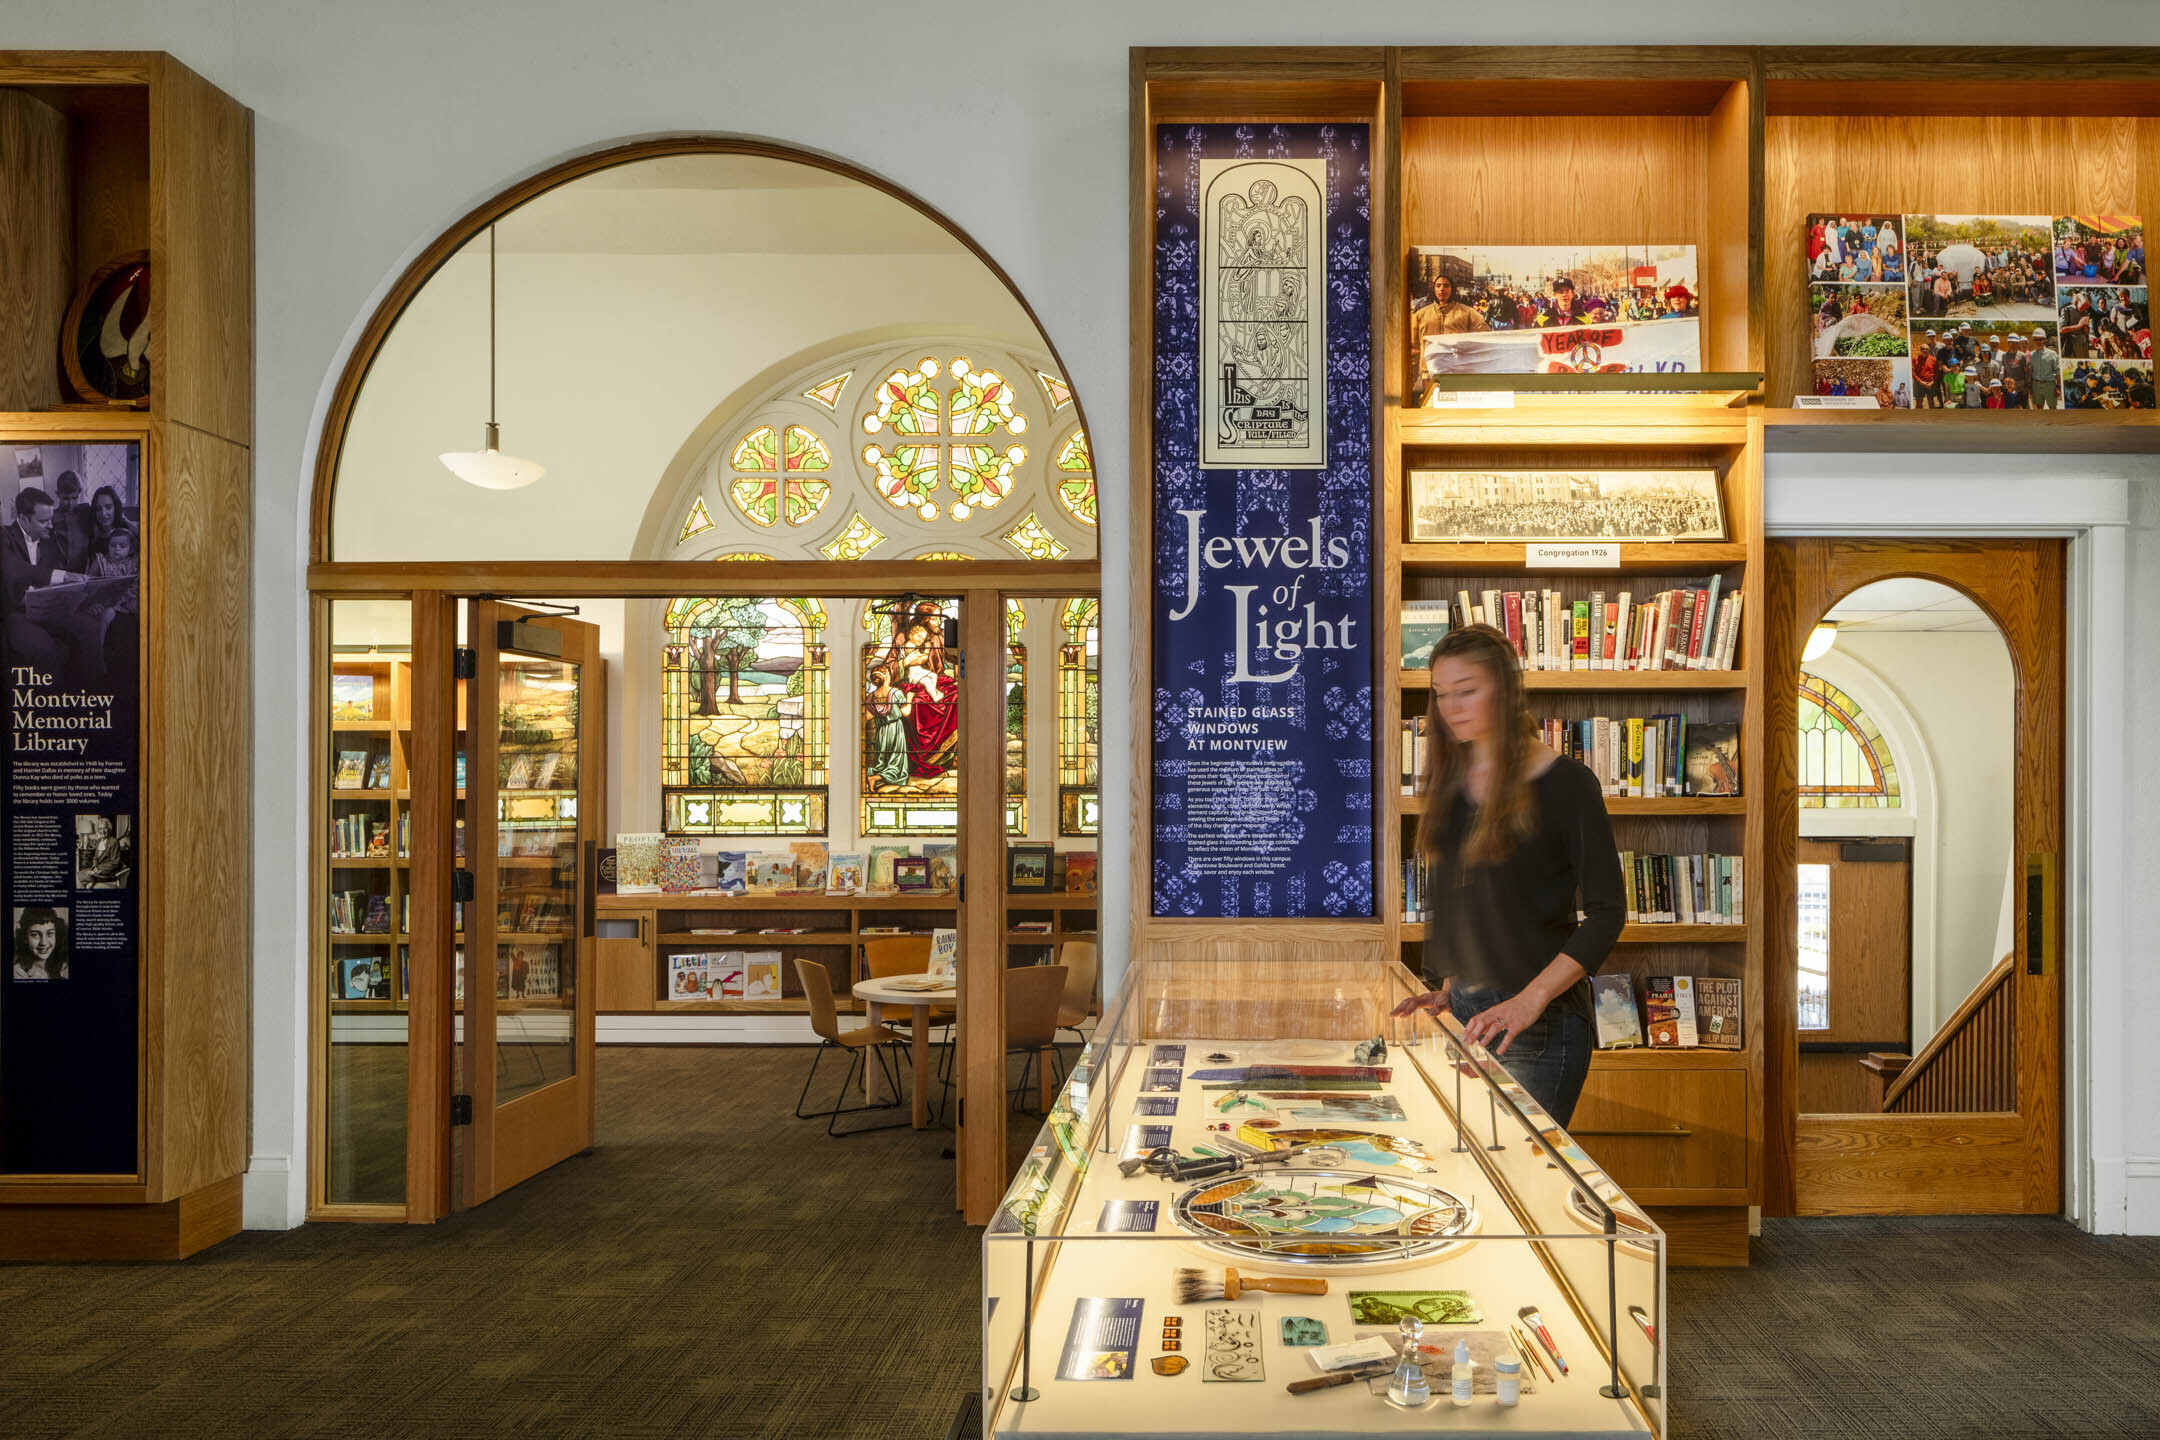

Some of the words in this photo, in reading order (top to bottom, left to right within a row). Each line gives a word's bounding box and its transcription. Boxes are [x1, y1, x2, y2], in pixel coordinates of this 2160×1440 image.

[1543, 331, 1586, 350] YEAR
[1590, 330, 1614, 344] OF
[1538, 549, 1589, 558] Congregation
[1169, 509, 1349, 621] Jewels
[1272, 574, 1304, 611] of
[1594, 594, 1602, 616] NELSON
[1683, 610, 1692, 629] HERE
[1224, 585, 1358, 683] Light
[12, 666, 52, 686] The
[12, 689, 114, 708] Montview
[13, 710, 112, 729] Memorial
[1187, 708, 1247, 718] STAINED
[1252, 708, 1294, 718] GLASS
[1187, 724, 1258, 734] WINDOWS
[13, 732, 88, 754] Library
[1188, 740, 1205, 750] AT
[1210, 740, 1288, 750] MONTVIEW
[1698, 982, 1714, 992] THE
[1716, 982, 1738, 993] PLOT
[1698, 994, 1738, 1005] AGAINST
[1698, 1006, 1738, 1018] AMERICA
[1721, 1035, 1738, 1043] ROTH
